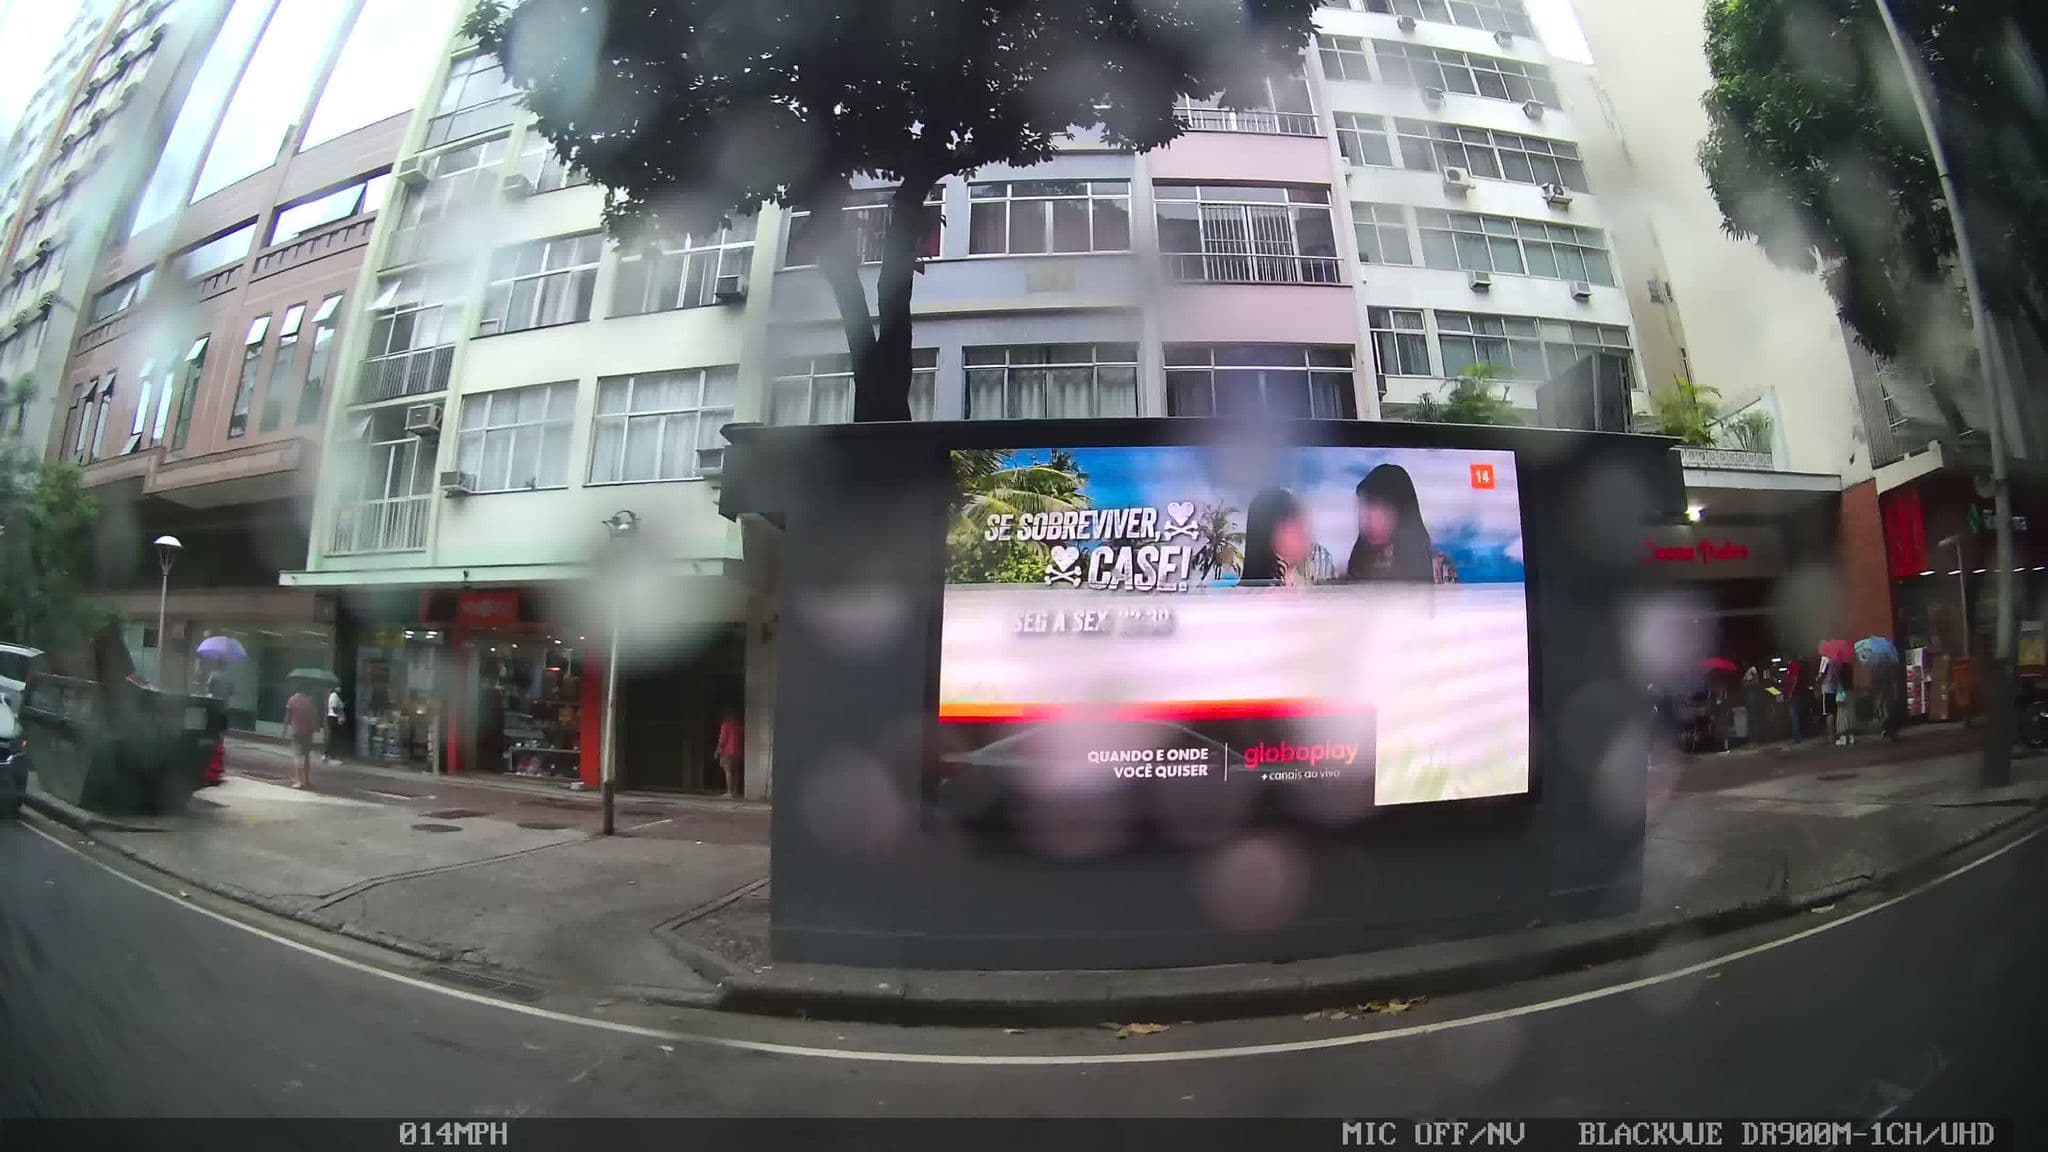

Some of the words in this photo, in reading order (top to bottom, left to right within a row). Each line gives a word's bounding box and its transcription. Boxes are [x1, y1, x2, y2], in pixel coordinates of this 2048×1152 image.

[1475, 470, 1490, 483] 14
[984, 513, 1014, 541] SE
[1017, 507, 1161, 542] SOBREVIVER,
[1088, 545, 1193, 592] CASE!
[1014, 609, 1048, 633] SEG
[1053, 609, 1066, 633] A
[1072, 609, 1110, 633] SEX
[1088, 749, 1154, 763] QUANDO
[1156, 749, 1165, 761] E
[1167, 748, 1209, 761] ONDE
[1243, 741, 1359, 769] globoplay
[1114, 763, 1153, 778] VOCÊ
[1155, 764, 1209, 779] QUISER
[1304, 770, 1318, 780] ao
[1319, 768, 1341, 779] vivo
